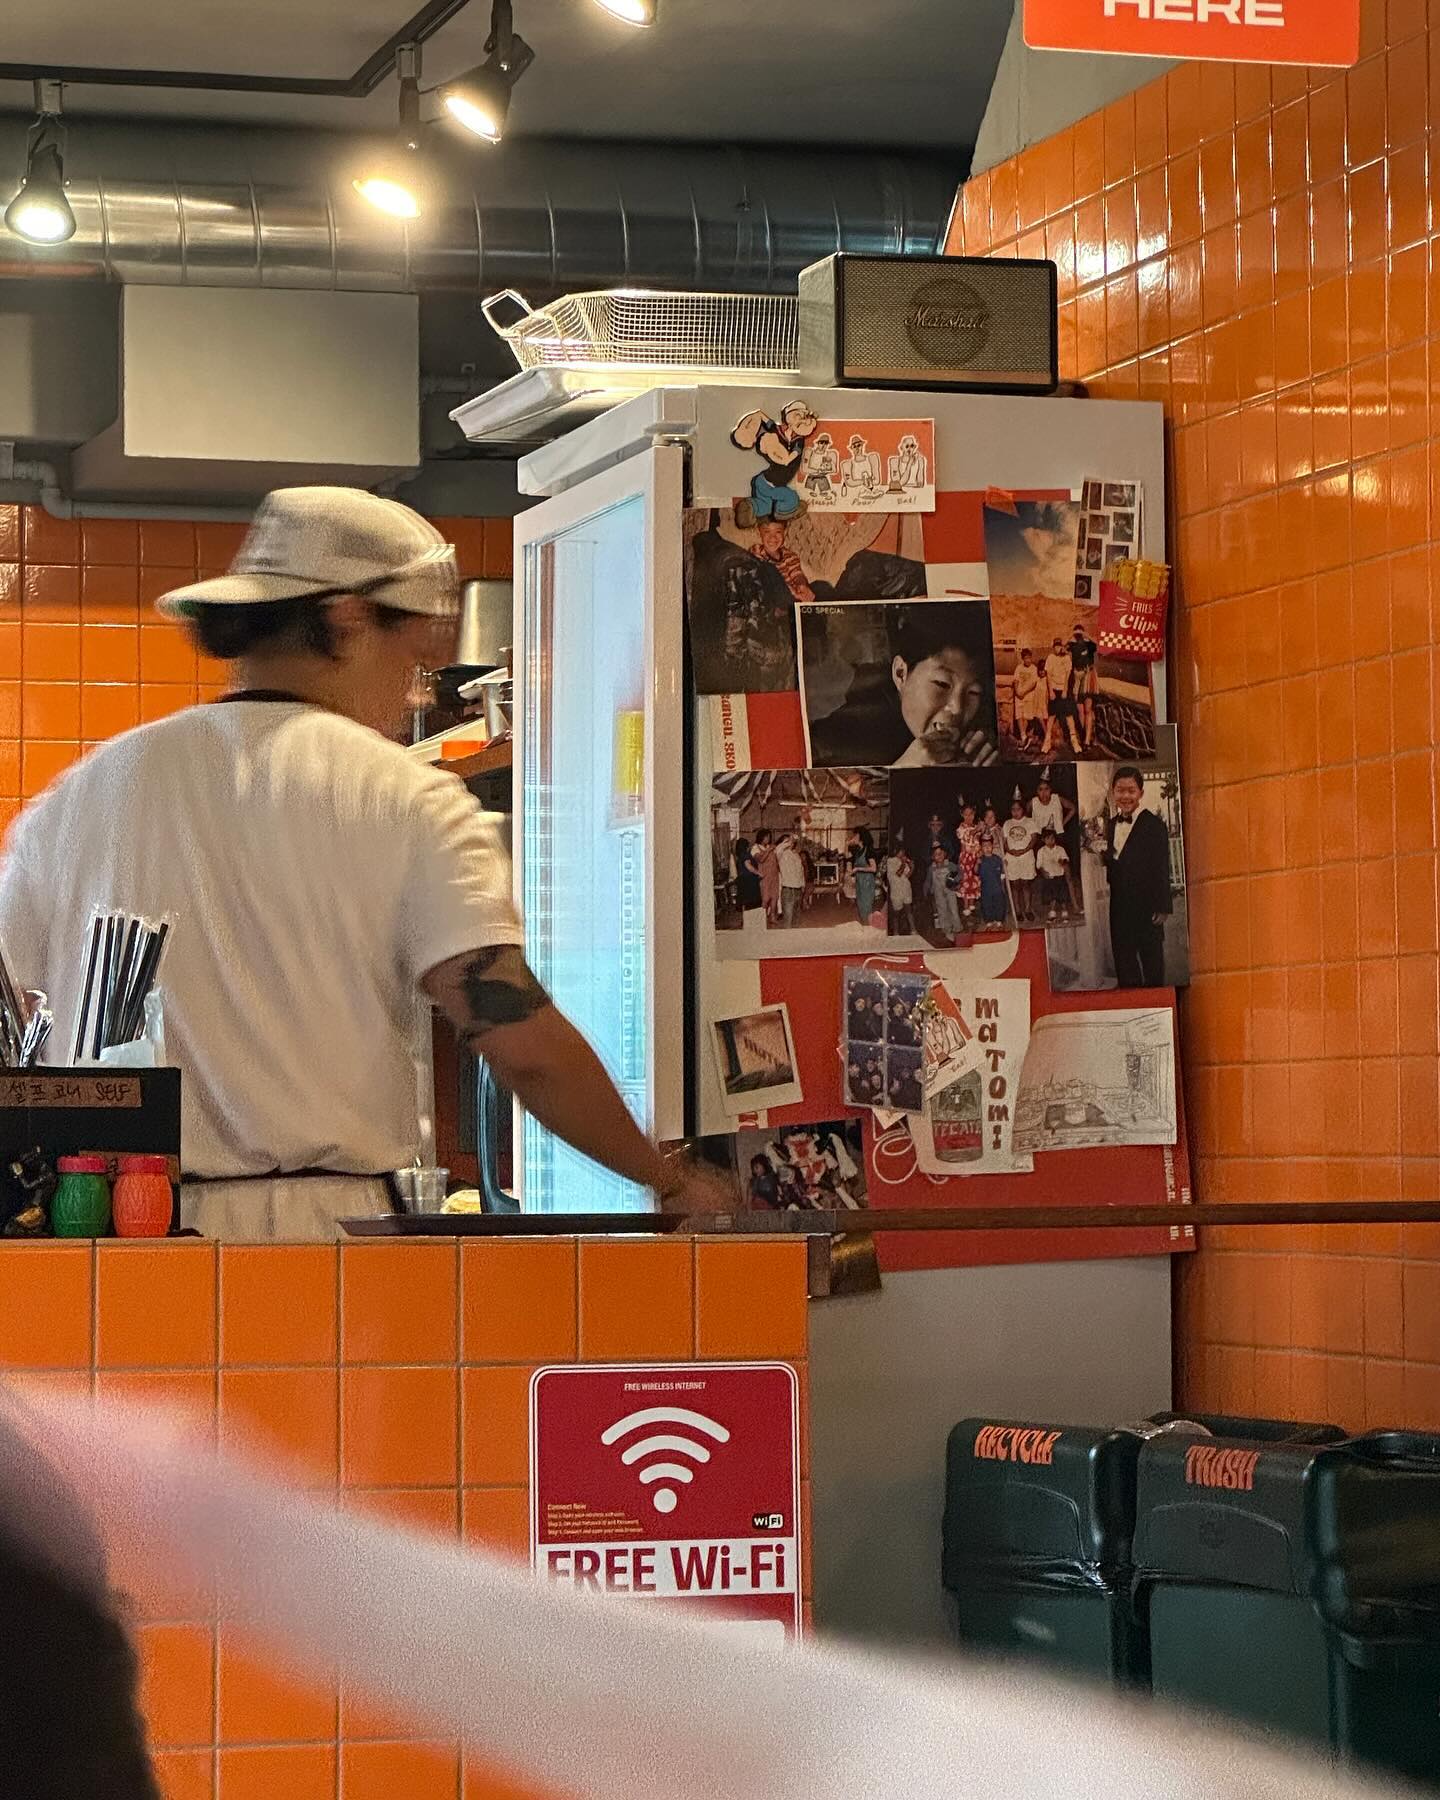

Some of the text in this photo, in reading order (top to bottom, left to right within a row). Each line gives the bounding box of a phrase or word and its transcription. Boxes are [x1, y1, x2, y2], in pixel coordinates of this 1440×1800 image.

[904, 304, 989, 328] Marshall
[815, 607, 845, 615] SPECIAL
[1132, 602, 1153, 614] FRIES
[1120, 614, 1158, 634] Clips
[95, 1081, 131, 1102] SELF
[624, 1382, 706, 1391] FREE WIRELESS INTERNET
[974, 1425, 1062, 1465] RECYCLE
[1185, 1445, 1260, 1490] TRASH
[548, 1543, 785, 1593] FREE Wi-Fi
